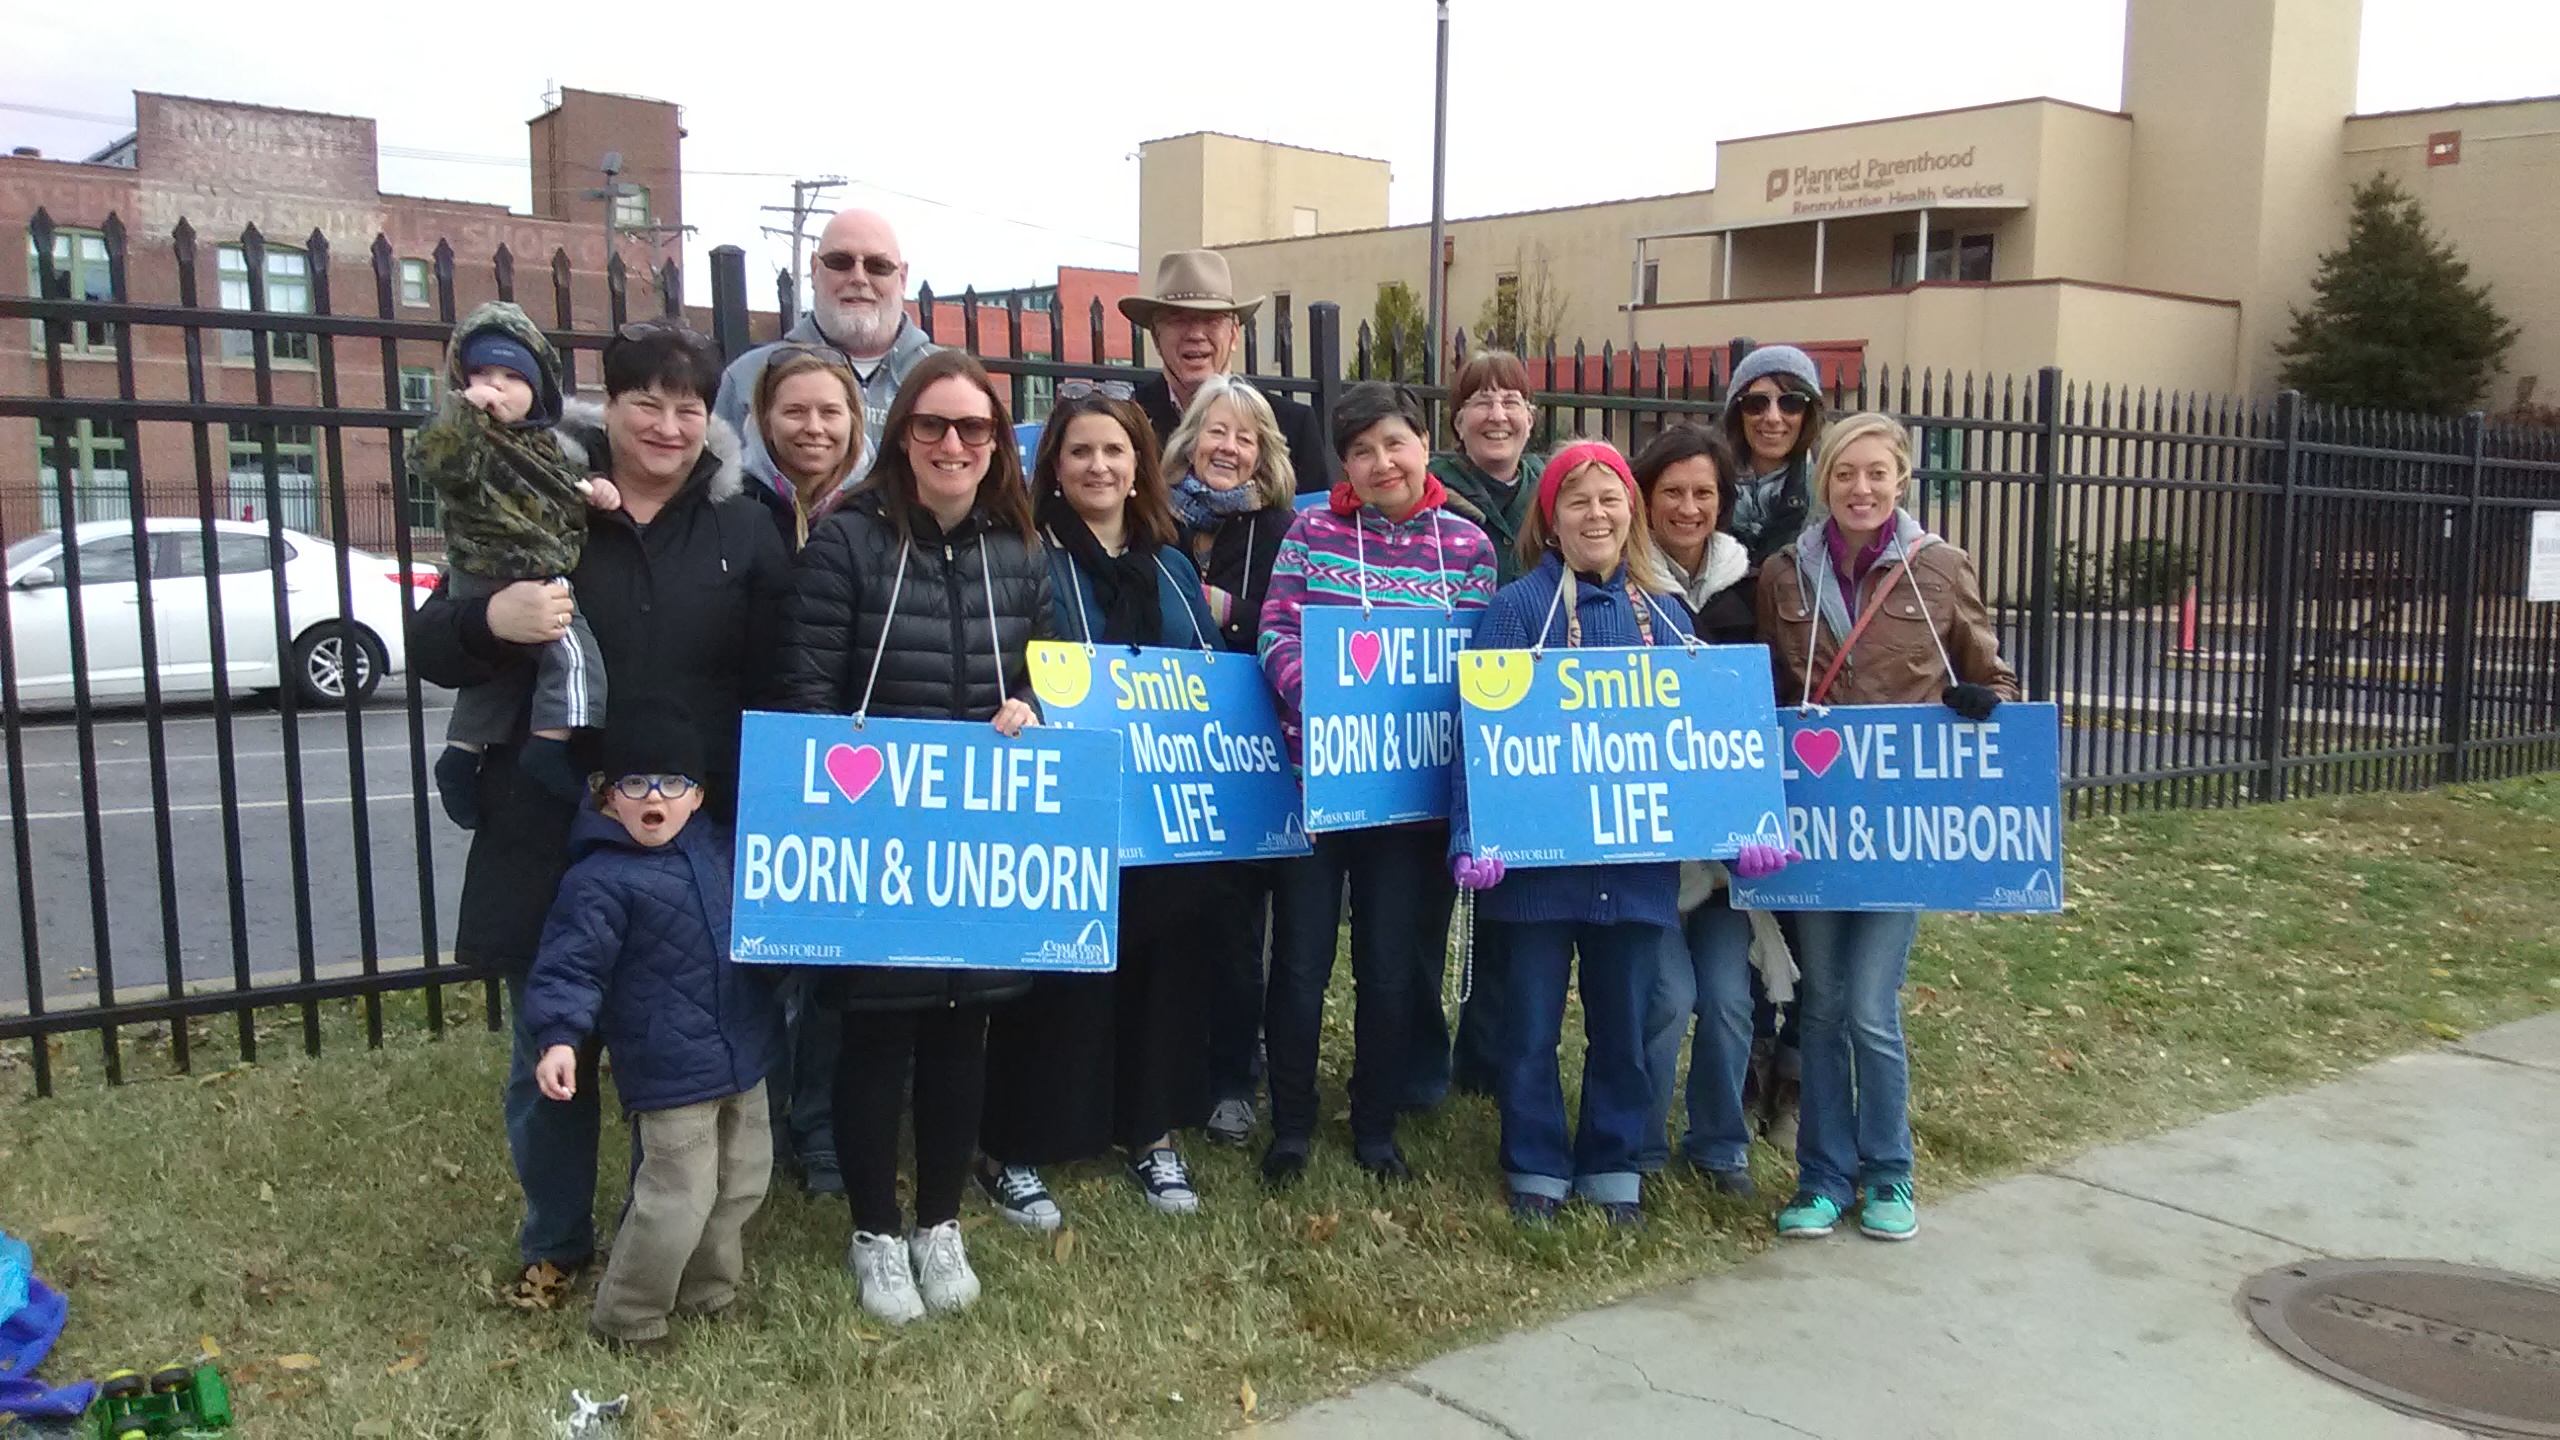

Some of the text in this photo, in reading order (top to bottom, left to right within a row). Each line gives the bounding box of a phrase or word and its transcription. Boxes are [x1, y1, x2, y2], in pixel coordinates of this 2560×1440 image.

[1794, 145, 1976, 185] Planned Parenthood
[1888, 186, 1936, 204] Health
[1941, 182, 2004, 199] Services
[1109, 657, 1210, 712] Smile
[1557, 653, 1681, 711] Smile
[1128, 721, 1203, 773] Mom
[1203, 719, 1281, 773] Chose
[1309, 711, 1463, 777] BORN & UNBO
[1480, 716, 1766, 776] Your Mom Chose
[1912, 722, 2004, 779] LIFE
[963, 746, 1061, 815] LIFE
[1153, 783, 1226, 845] LIFE
[1589, 782, 1674, 846] LIFE
[1788, 804, 2053, 862] RN & UNBORN
[744, 834, 1109, 911] BORN & UNBORN
